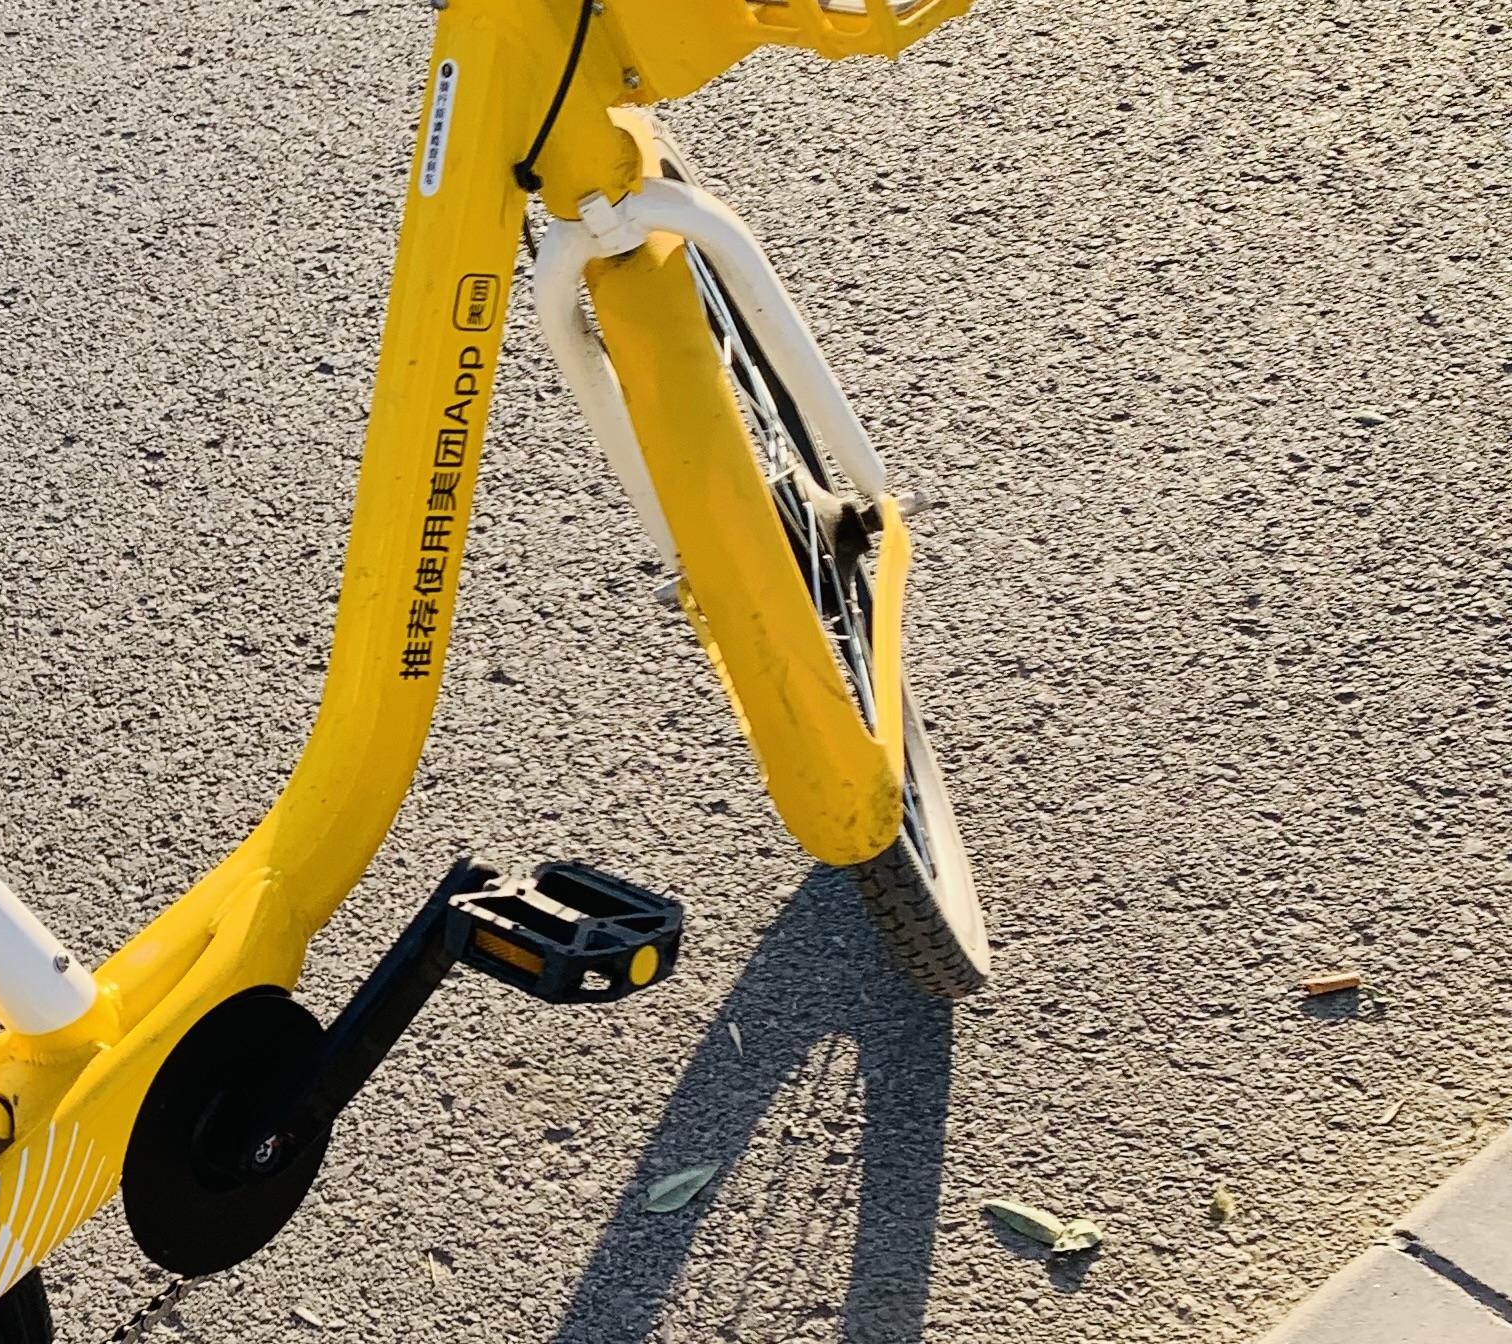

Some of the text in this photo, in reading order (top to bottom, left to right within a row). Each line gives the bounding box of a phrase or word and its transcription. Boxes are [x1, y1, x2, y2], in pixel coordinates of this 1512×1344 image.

[466, 279, 489, 327] 美团
[399, 345, 484, 681] 推荐使用美团App
